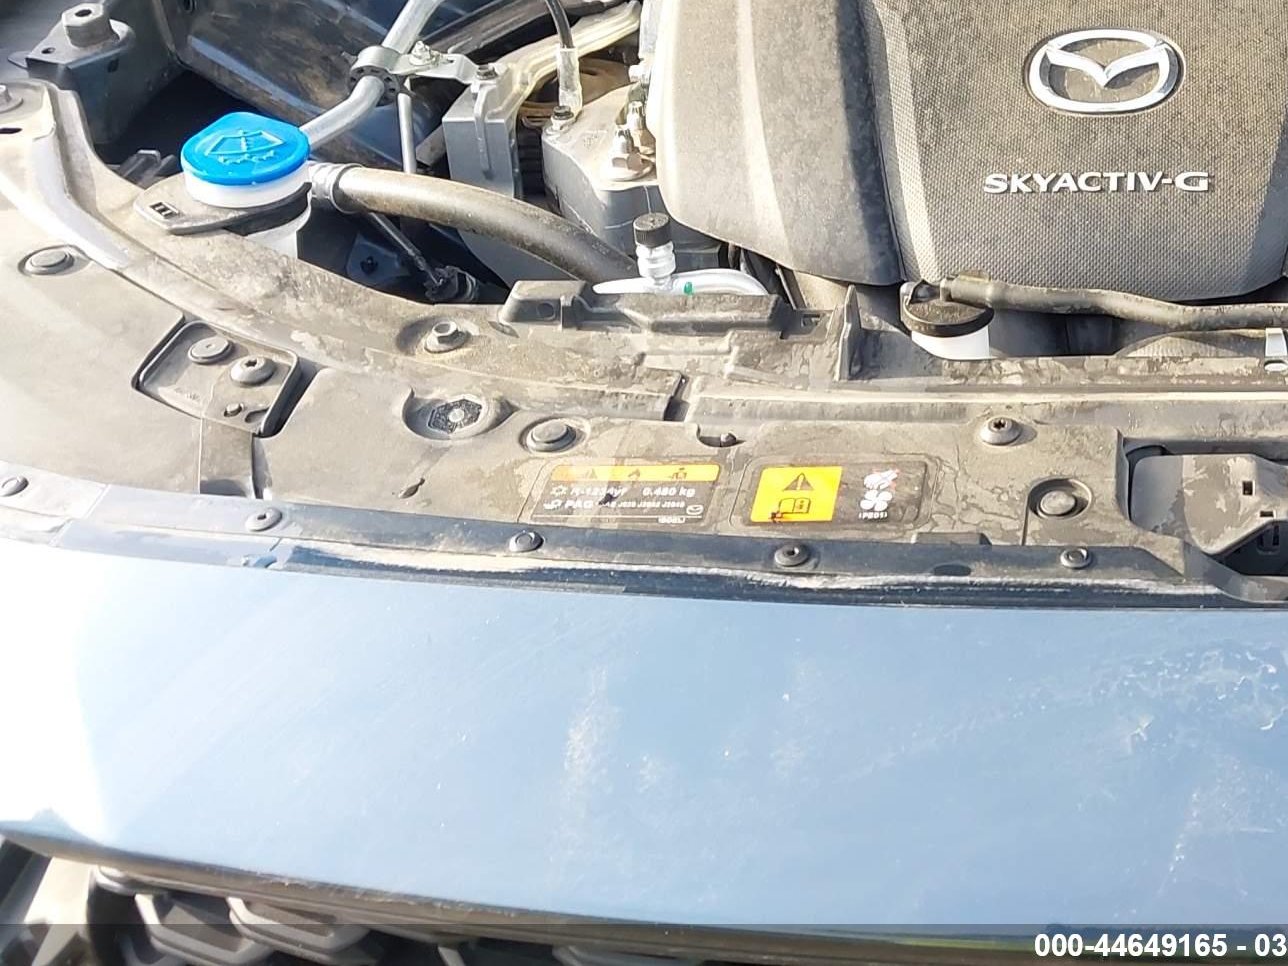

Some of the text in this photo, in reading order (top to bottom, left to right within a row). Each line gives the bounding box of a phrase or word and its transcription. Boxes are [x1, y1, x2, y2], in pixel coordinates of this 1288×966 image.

[983, 171, 1209, 194] SKYACTIV-G
[679, 486, 696, 498] kg
[565, 500, 594, 508] PAG
